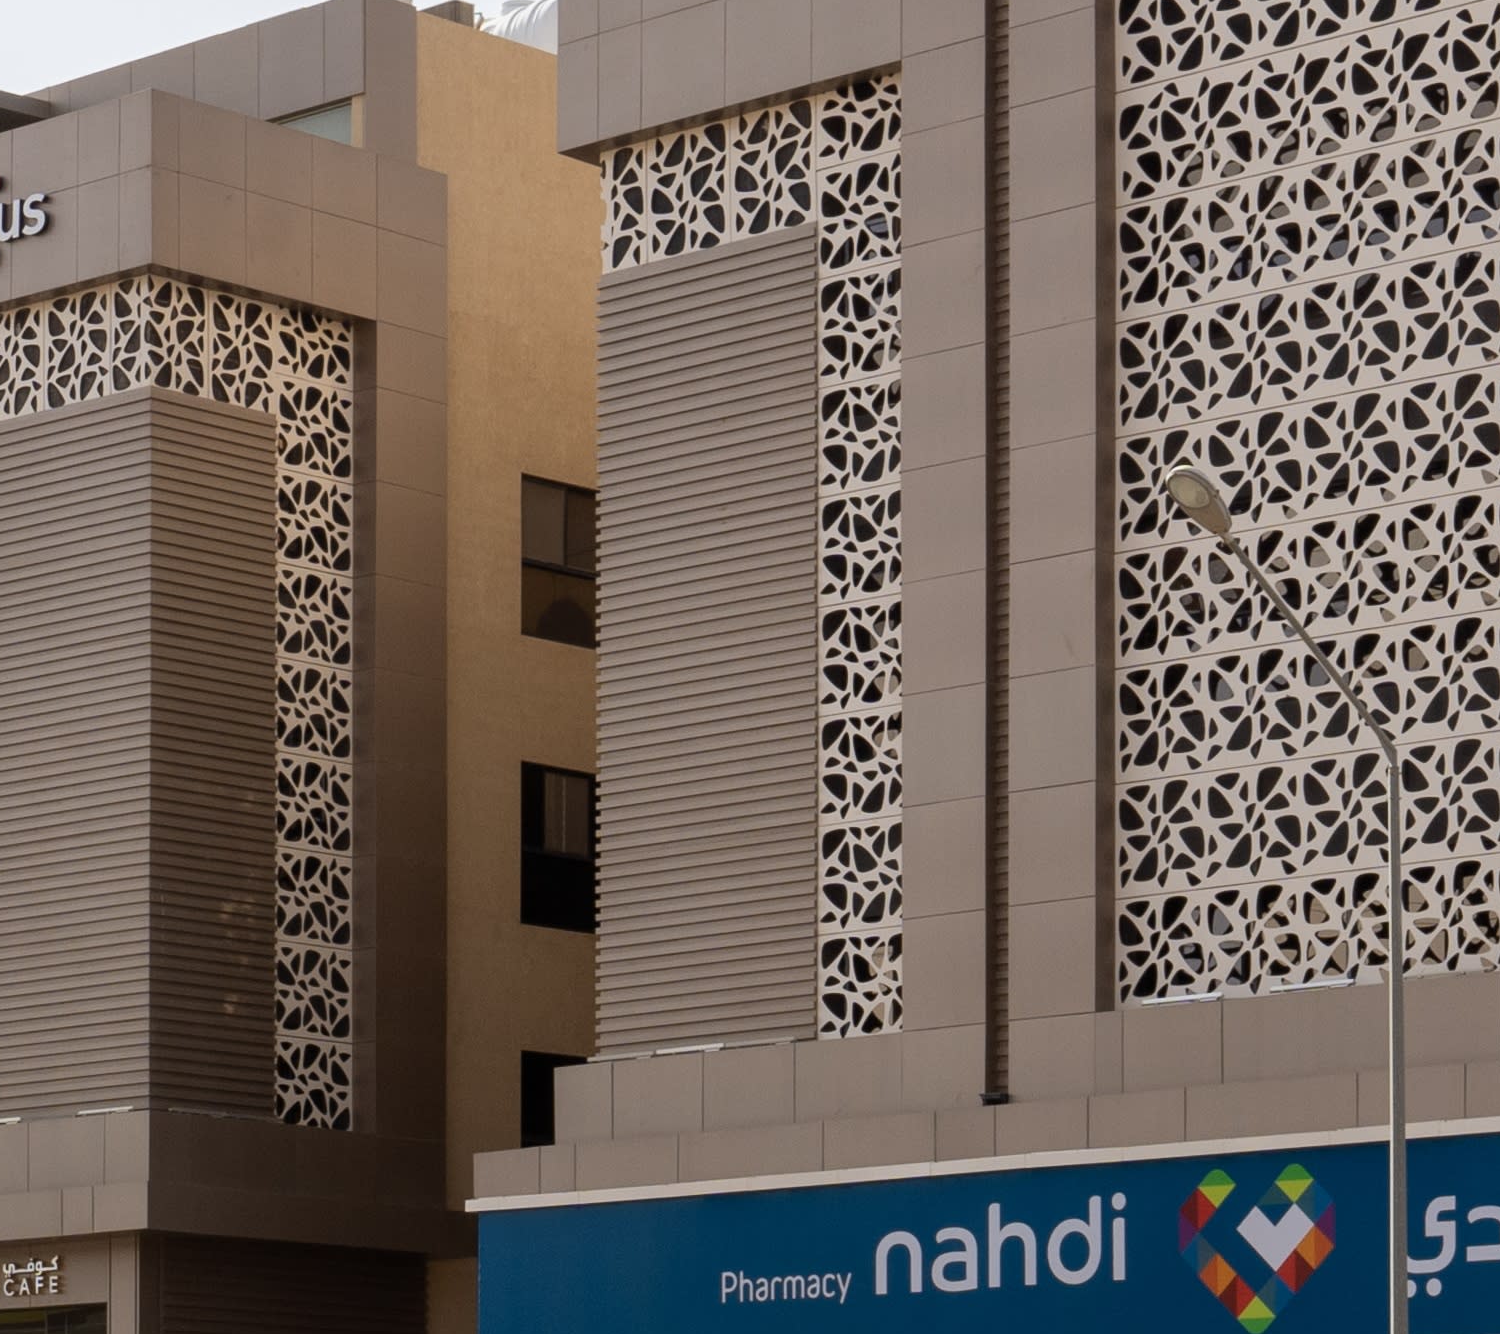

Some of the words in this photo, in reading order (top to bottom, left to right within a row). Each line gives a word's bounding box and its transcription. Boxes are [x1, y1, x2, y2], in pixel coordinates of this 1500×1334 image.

[721, 1270, 852, 1304] Pharmacy
[875, 1192, 1127, 1295] nahdi
[3, 1255, 59, 1278] كوفي
[3, 1275, 59, 1297] CAFE
